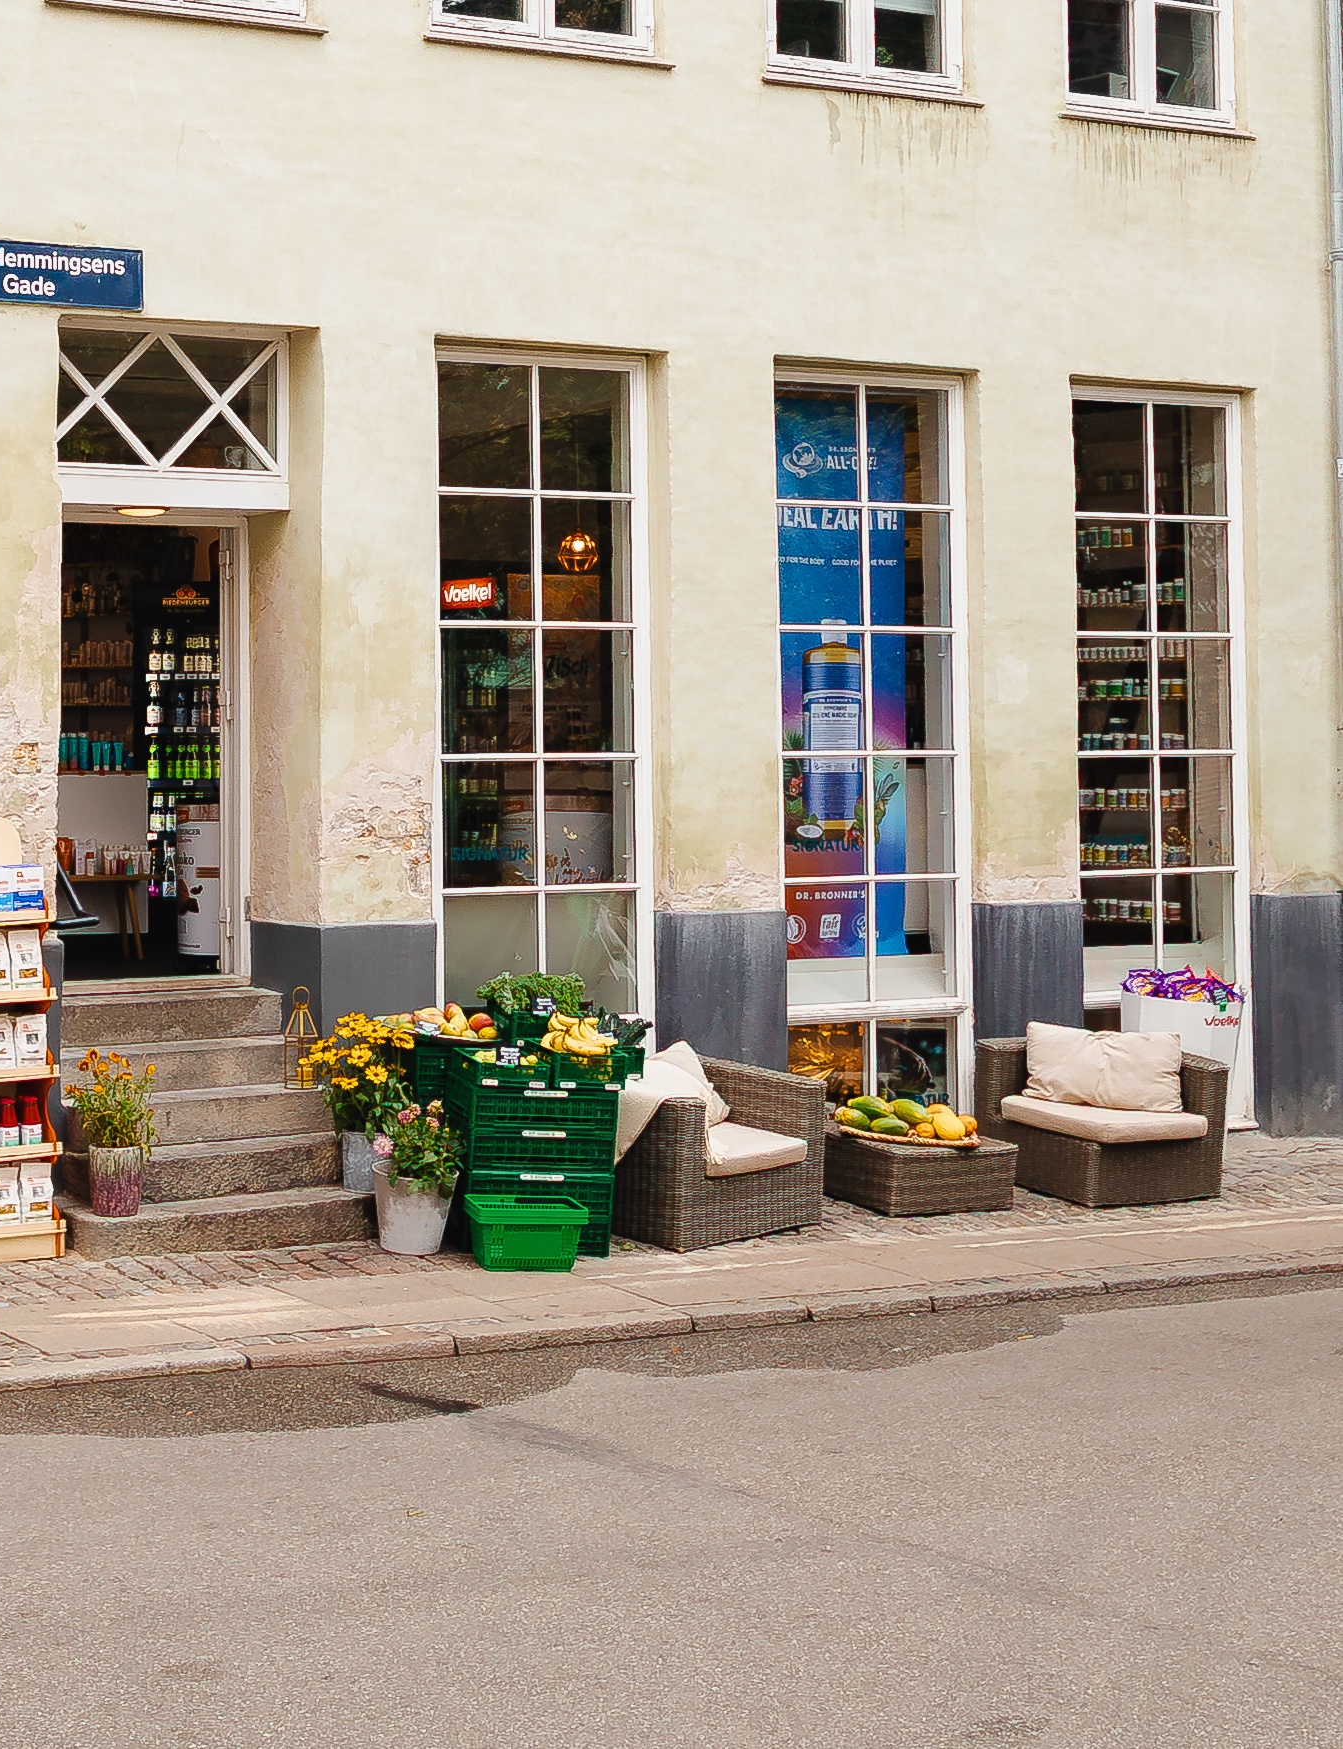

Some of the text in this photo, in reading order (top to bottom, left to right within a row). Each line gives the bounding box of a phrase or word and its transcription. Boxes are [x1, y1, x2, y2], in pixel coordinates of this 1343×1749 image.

[2, 273, 56, 297] Gade
[826, 454, 878, 471] ALL-OE!
[444, 582, 492, 603] Voelkel
[451, 846, 529, 862] SIGNATUR
[791, 839, 861, 853] SIGNATUR
[795, 892, 813, 900] DR.
